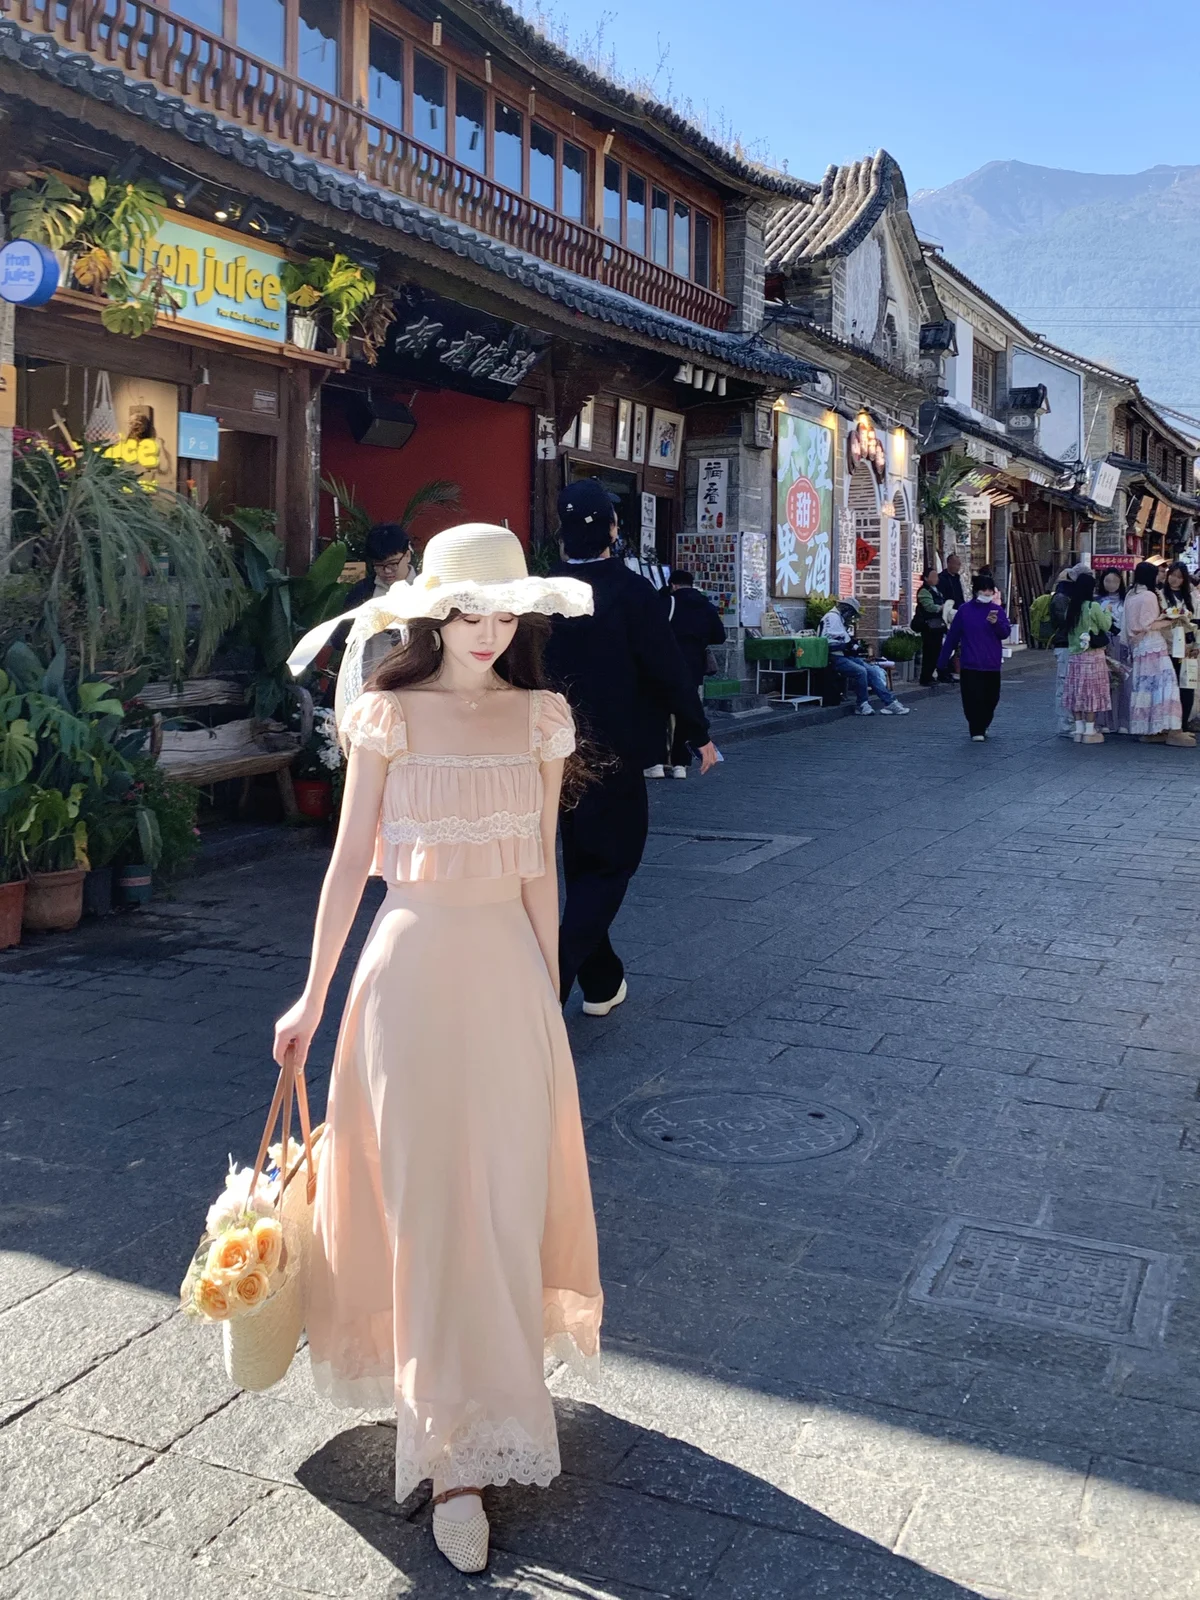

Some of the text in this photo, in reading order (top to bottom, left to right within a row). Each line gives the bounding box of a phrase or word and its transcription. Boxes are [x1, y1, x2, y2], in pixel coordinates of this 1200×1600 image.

[1, 268, 36, 286] juice
[195, 247, 281, 311] juice
[777, 416, 833, 491] 大理
[796, 491, 812, 529] 甜
[775, 522, 832, 600] 果酒
